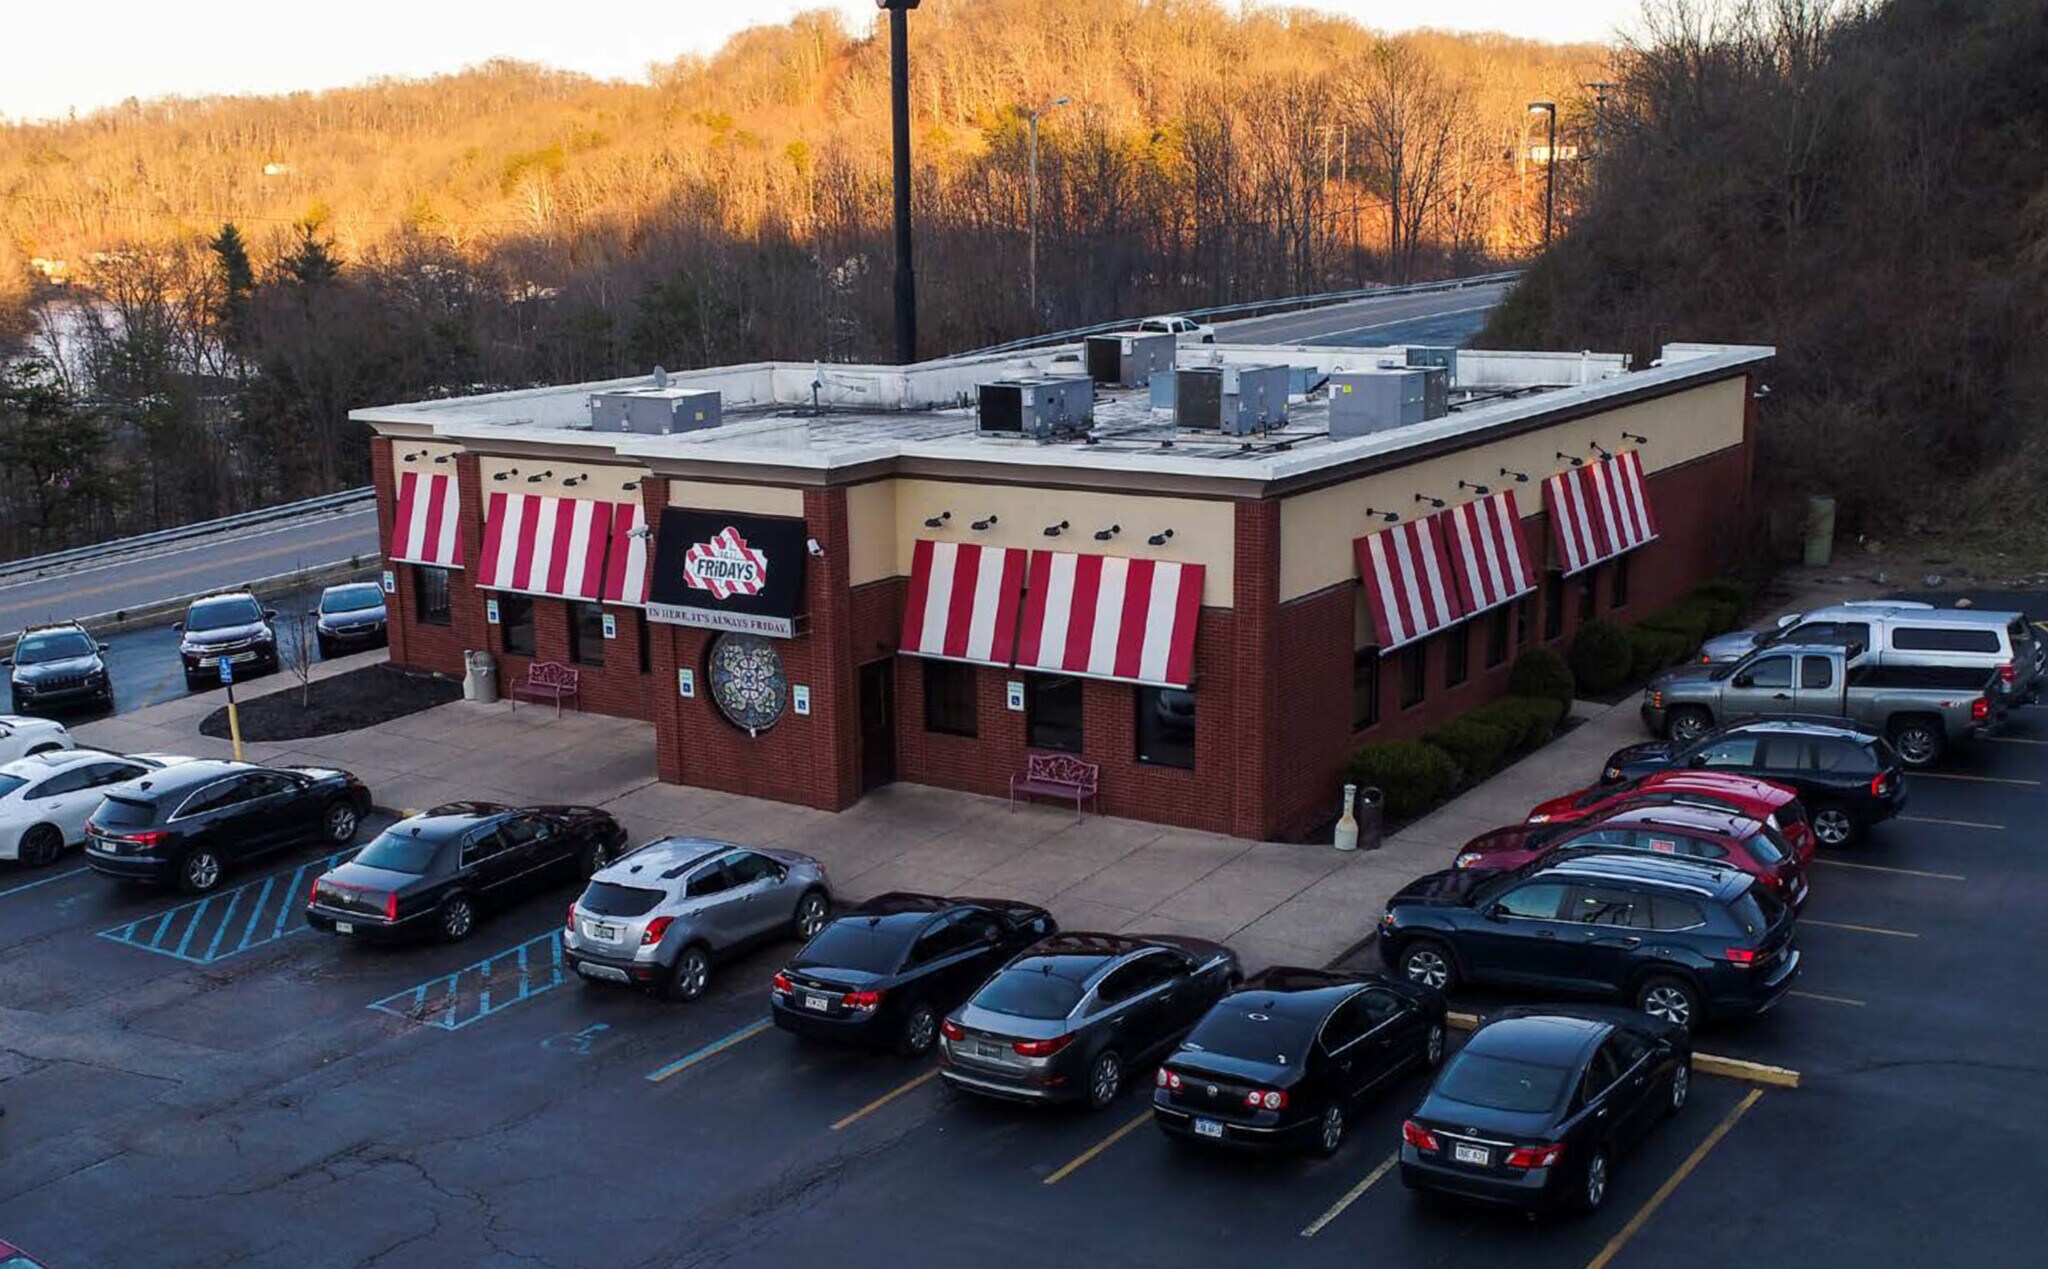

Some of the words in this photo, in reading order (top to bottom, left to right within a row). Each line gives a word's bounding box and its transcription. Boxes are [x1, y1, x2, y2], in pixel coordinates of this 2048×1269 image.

[648, 607, 660, 617] IN
[692, 613, 710, 623] IT'S
[713, 616, 749, 629] ALWAYS
[750, 620, 789, 634] FRIDAY.
